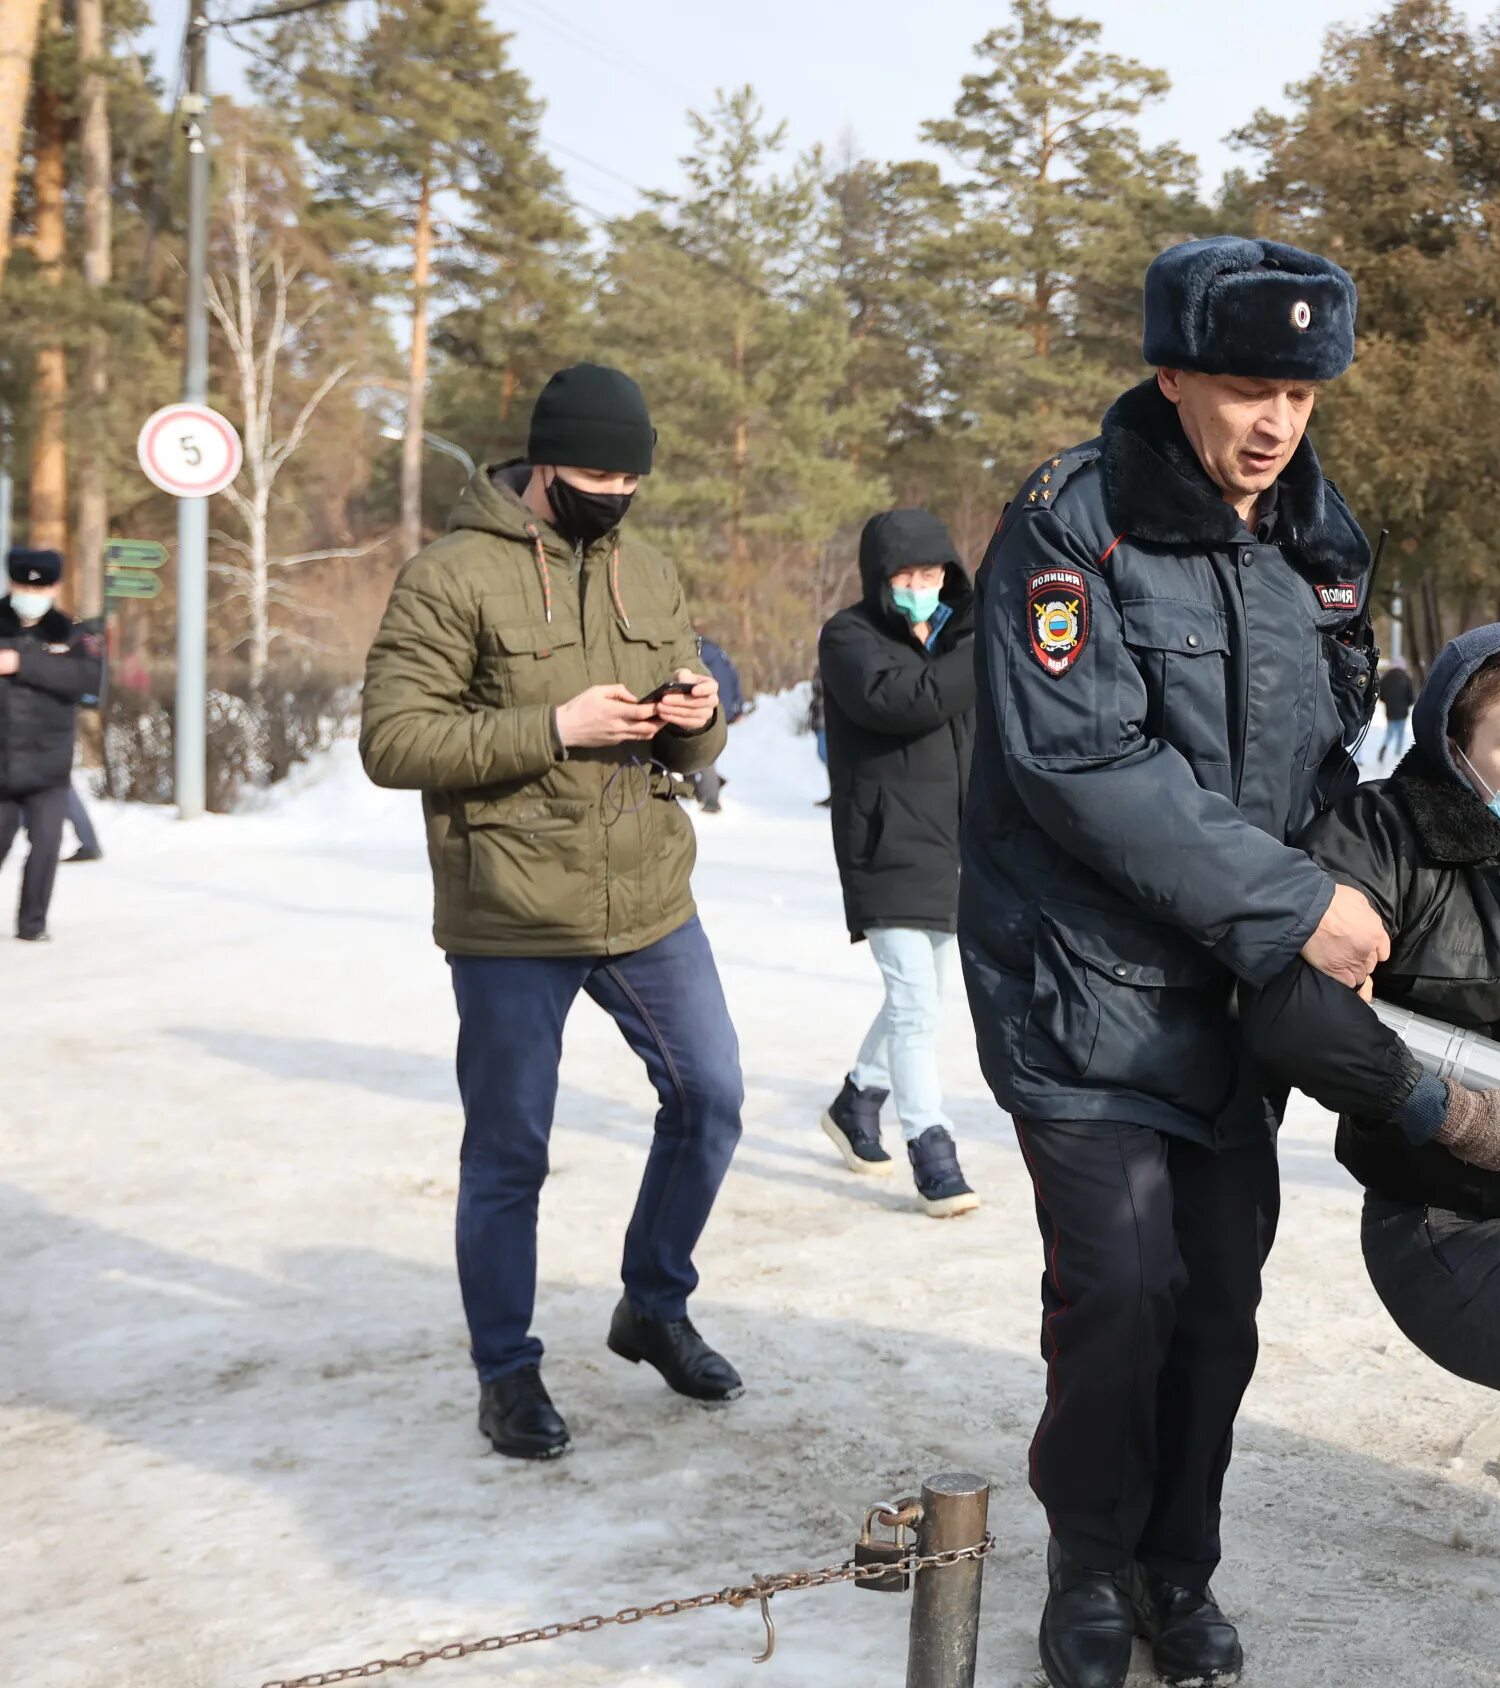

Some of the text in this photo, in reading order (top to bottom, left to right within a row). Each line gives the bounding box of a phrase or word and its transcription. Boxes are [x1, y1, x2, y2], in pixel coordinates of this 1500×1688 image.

[180, 435, 203, 467] 5
[1031, 572, 1081, 590] ПОЛИЦИЯ
[1047, 656, 1069, 672] МВД
